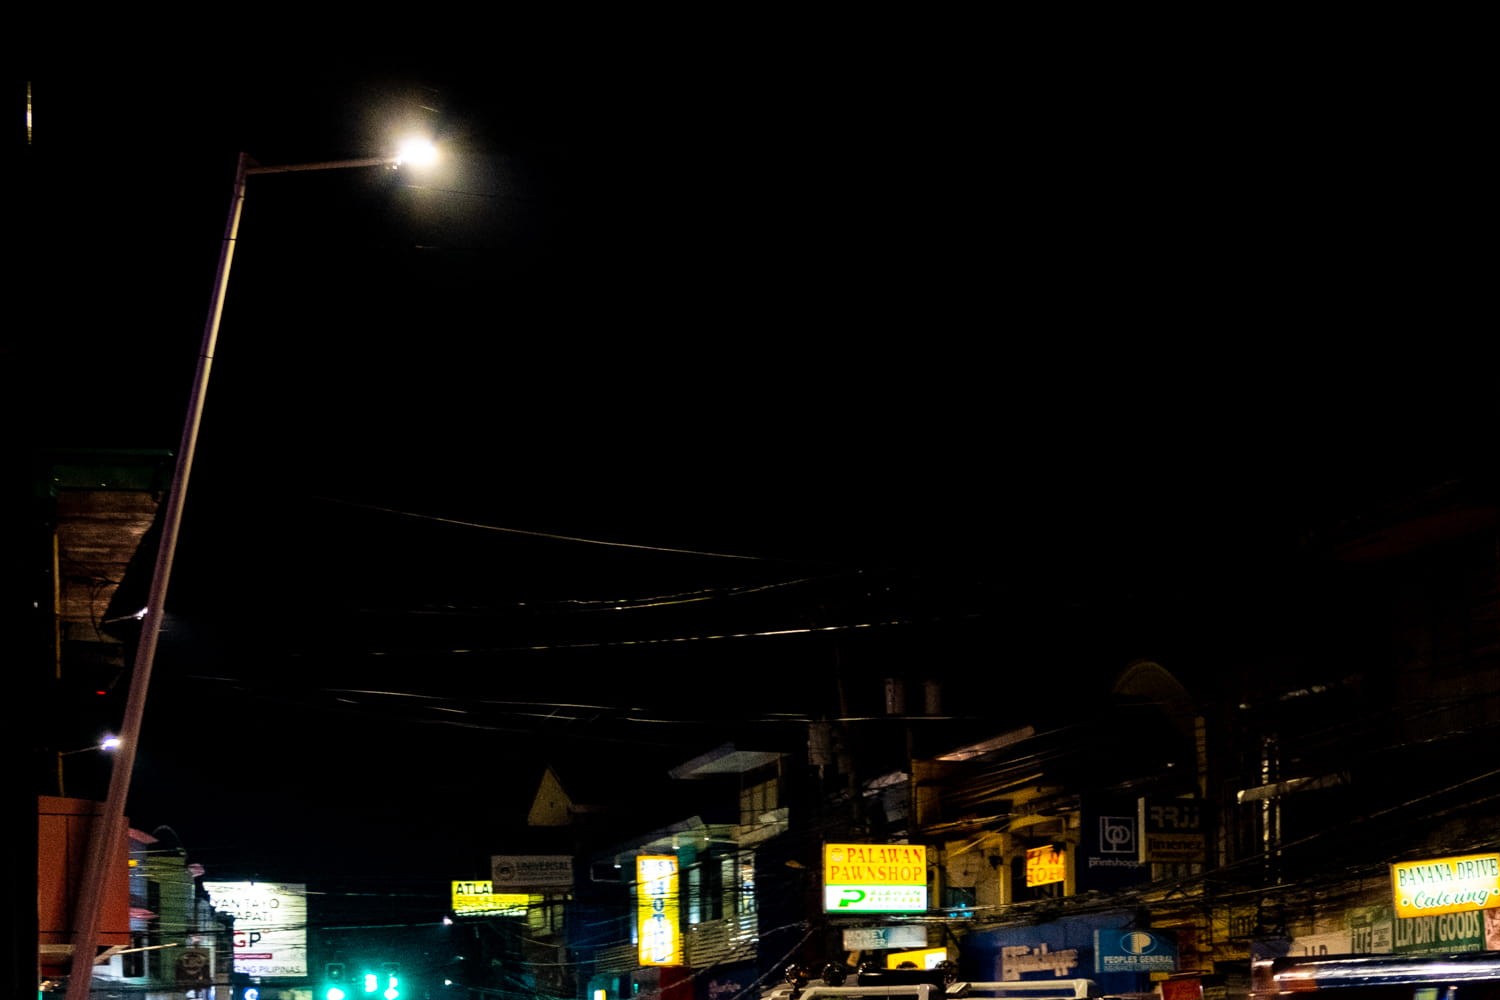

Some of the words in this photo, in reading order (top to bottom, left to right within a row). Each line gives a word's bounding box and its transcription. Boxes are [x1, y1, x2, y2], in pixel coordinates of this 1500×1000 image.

[847, 847, 922, 863] PALAWAN
[830, 865, 922, 881] PAWNSHOP
[1398, 863, 1453, 887] BANANA
[1457, 858, 1499, 880] DRIVE
[456, 883, 491, 895] ATLA
[1414, 888, 1488, 908] Catering
[1416, 915, 1436, 945] DRY
[1438, 910, 1481, 941] GOODS
[1104, 955, 1137, 964] PEOPLES
[1139, 955, 1173, 963] GENERAL
